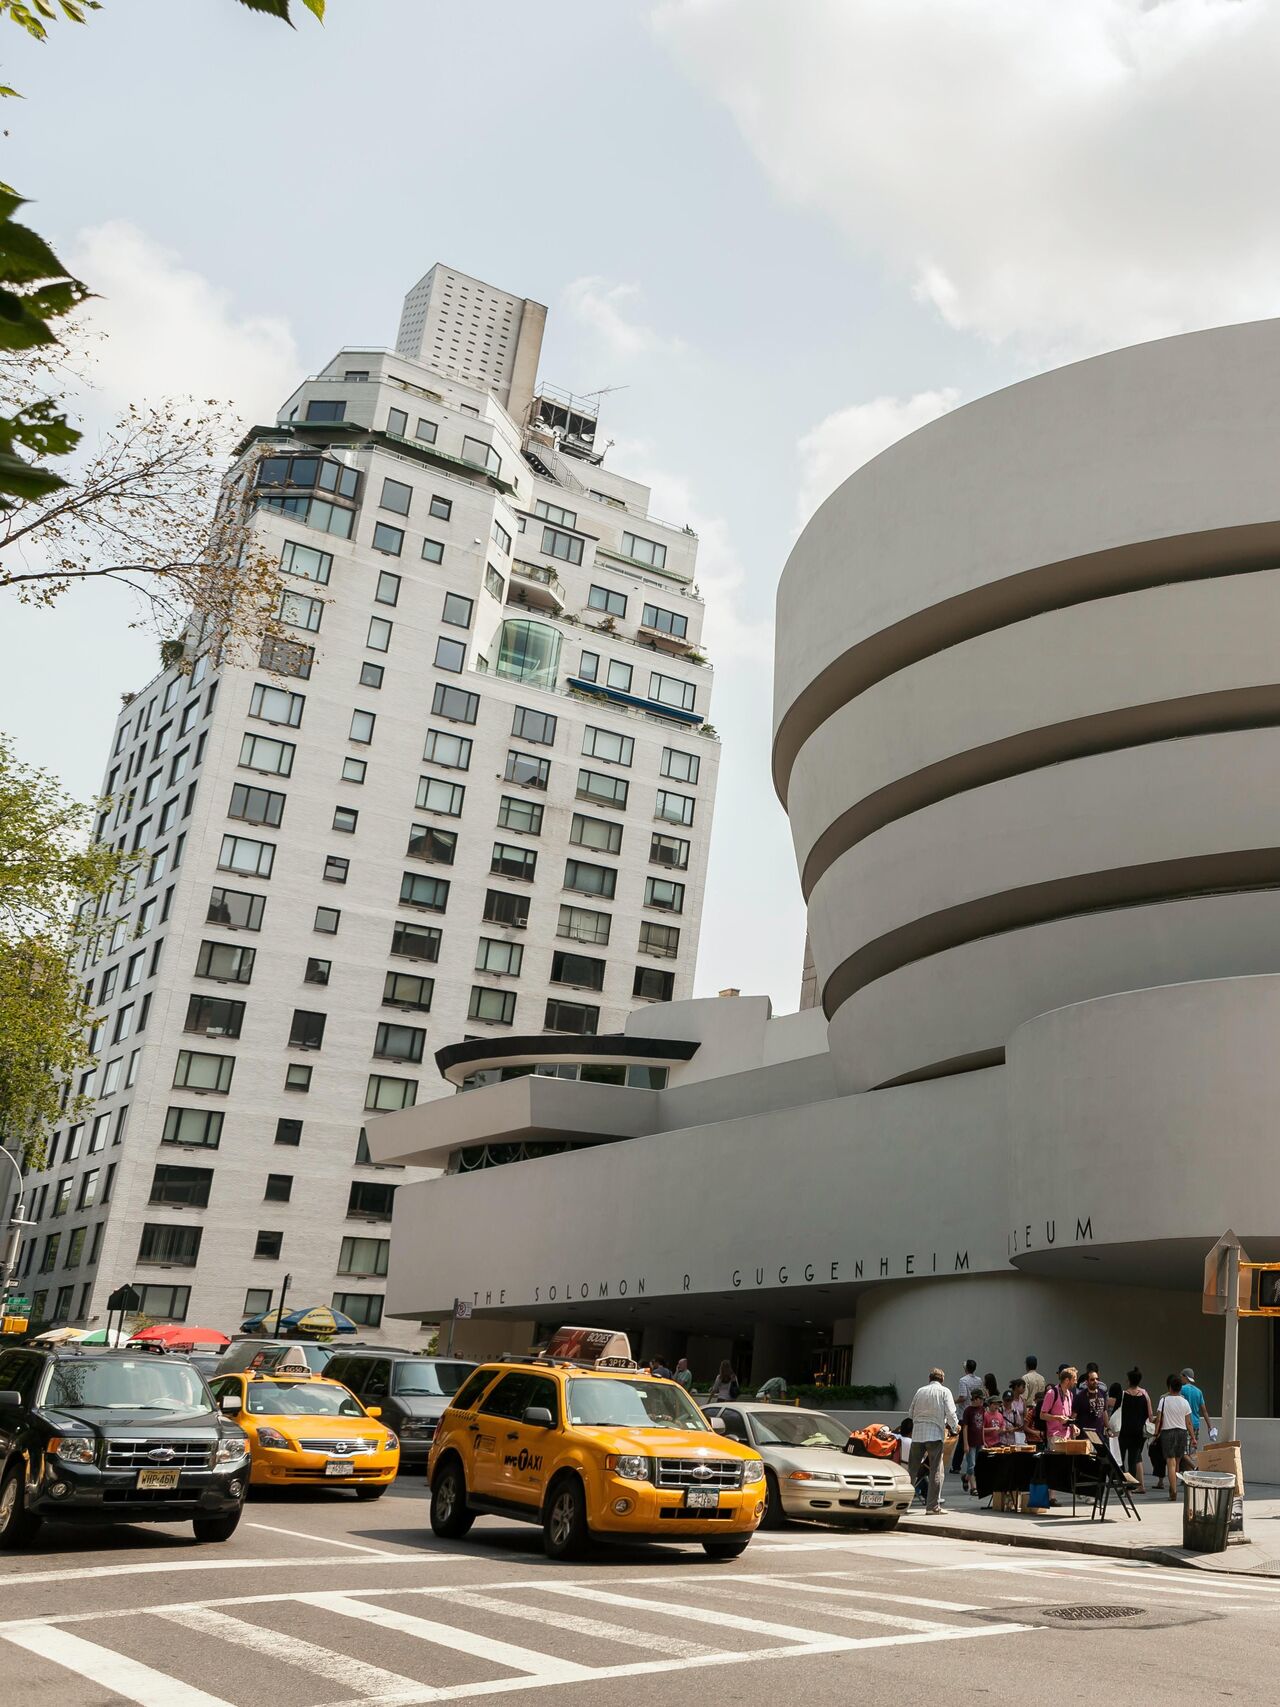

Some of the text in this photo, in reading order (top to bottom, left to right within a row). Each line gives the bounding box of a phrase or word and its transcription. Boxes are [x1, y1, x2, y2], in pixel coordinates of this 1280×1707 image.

[473, 1289, 506, 1306] THE
[535, 1278, 646, 1302] SOLOMON
[683, 1274, 691, 1291] R
[732, 1251, 970, 1287] GUGGENHEIM
[586, 1332, 612, 1343] BODIES
[608, 1358, 626, 1368] 3P12
